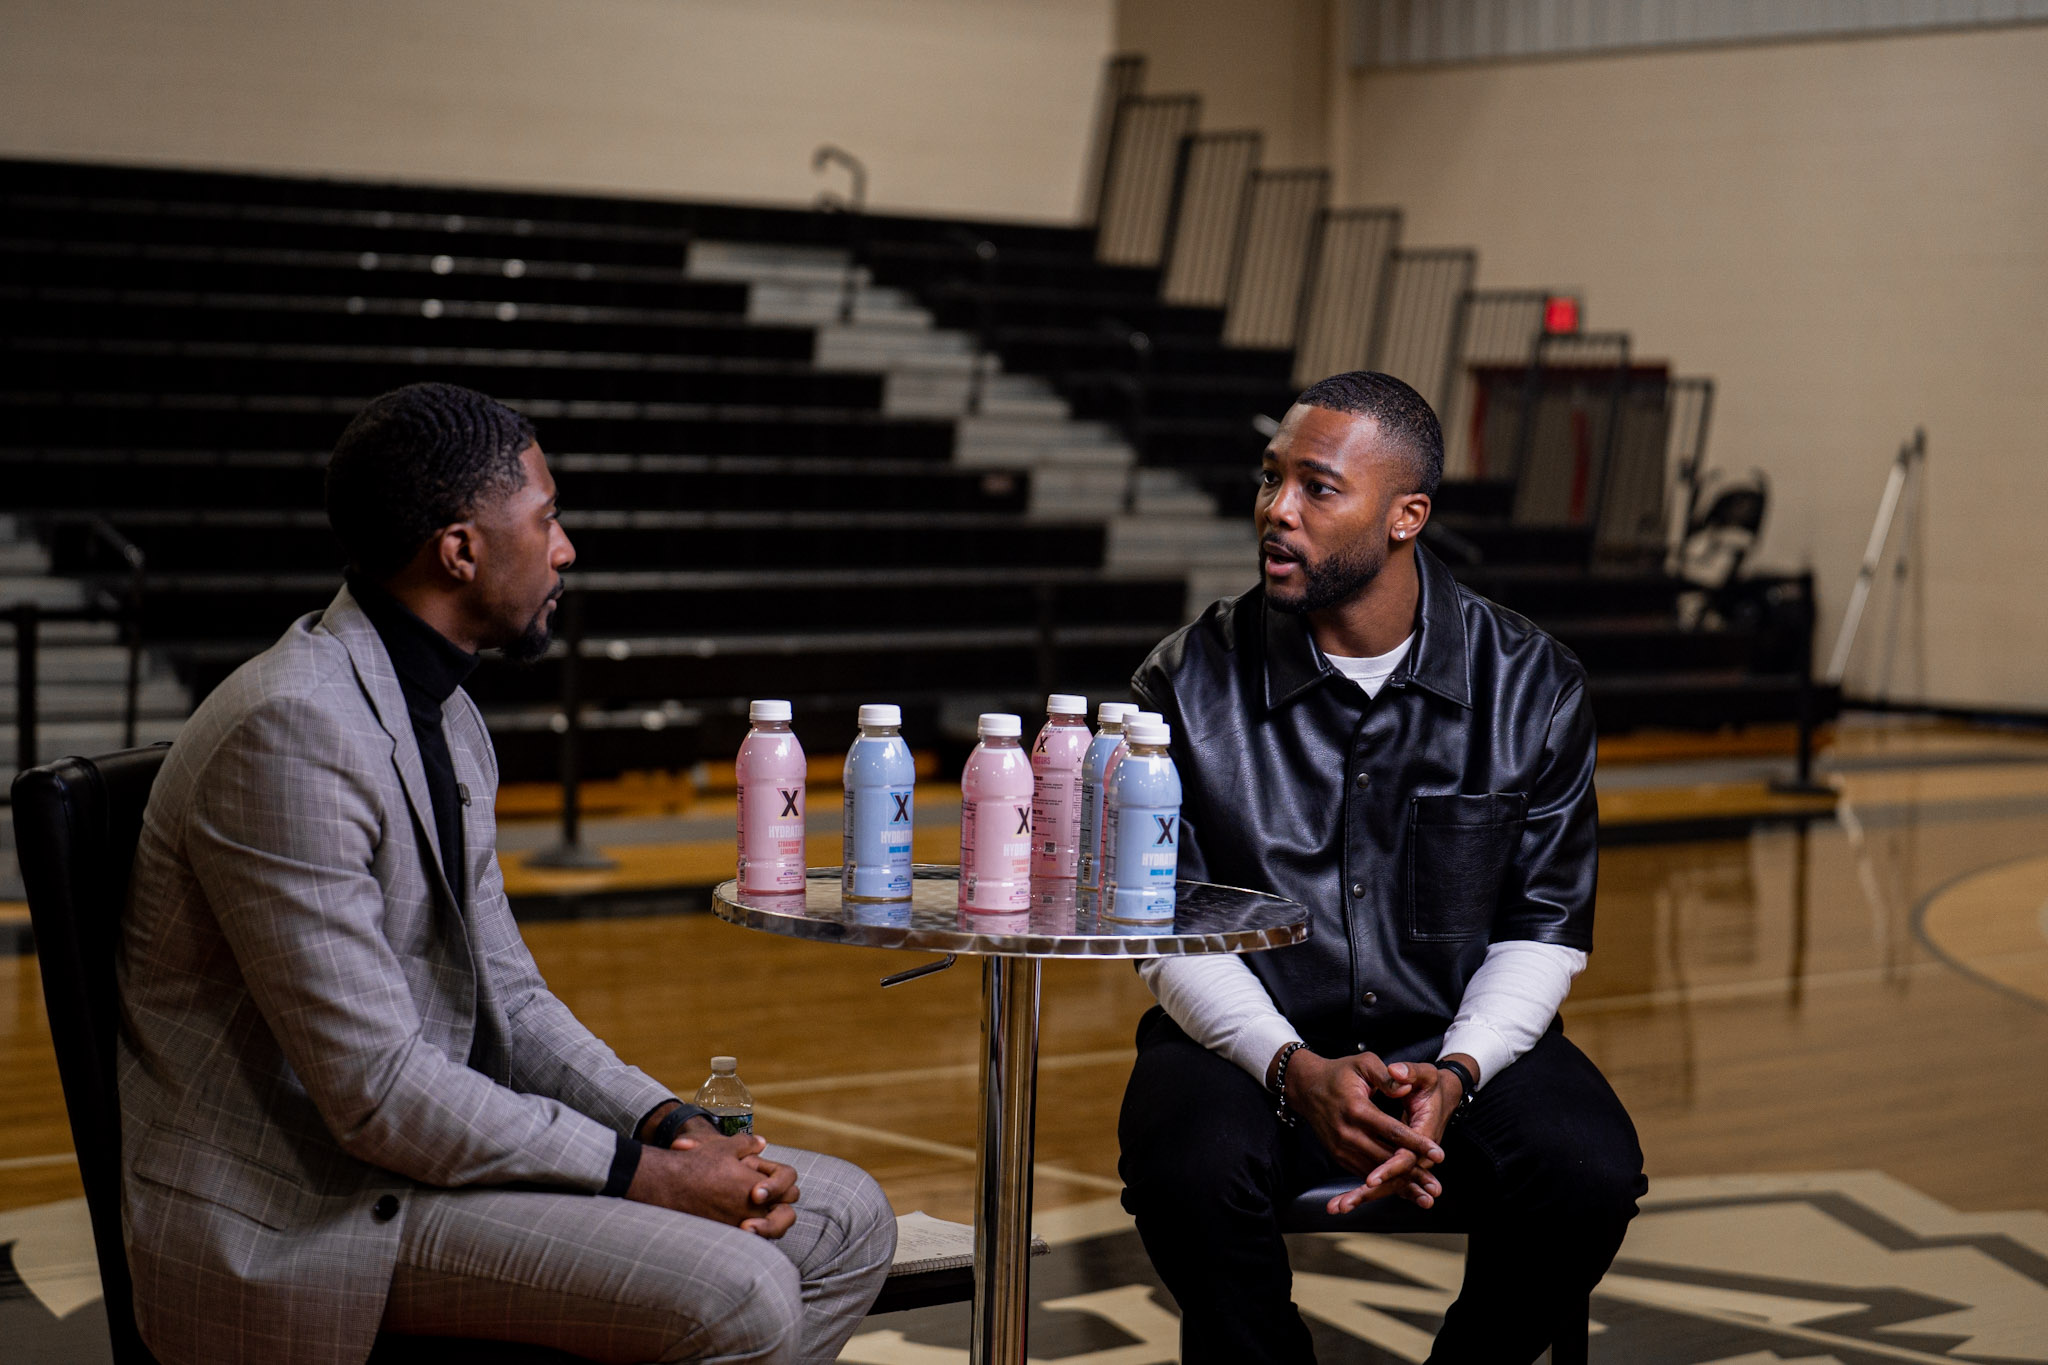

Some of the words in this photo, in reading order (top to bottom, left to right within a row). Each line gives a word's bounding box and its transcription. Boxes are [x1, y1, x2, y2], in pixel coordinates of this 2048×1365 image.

[1036, 736, 1049, 753] X
[778, 788, 800, 818] X
[891, 792, 910, 822] X
[1014, 806, 1031, 836] X
[1154, 815, 1175, 846] X
